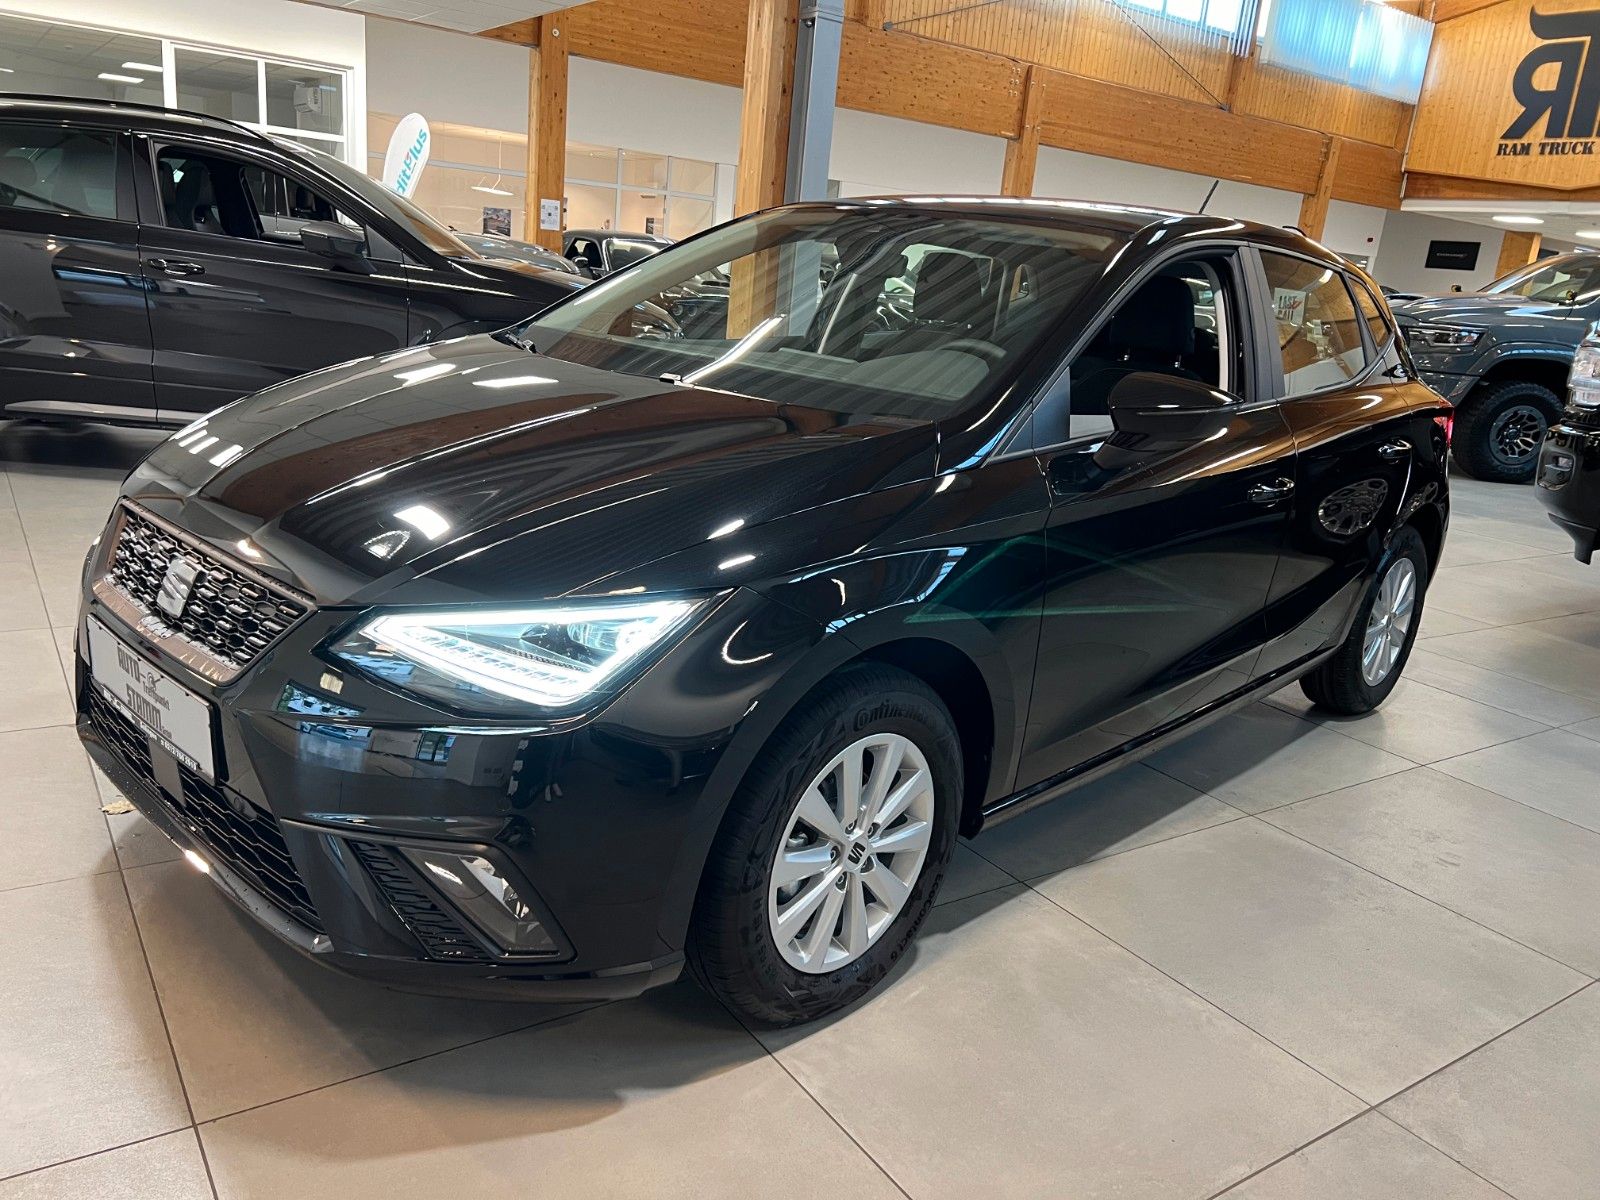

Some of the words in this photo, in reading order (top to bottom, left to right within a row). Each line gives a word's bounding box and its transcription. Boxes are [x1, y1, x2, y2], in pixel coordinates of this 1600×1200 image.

[1496, 142, 1533, 156] RAM
[1538, 140, 1596, 155] TRUCK
[126, 683, 163, 731] STAMM
